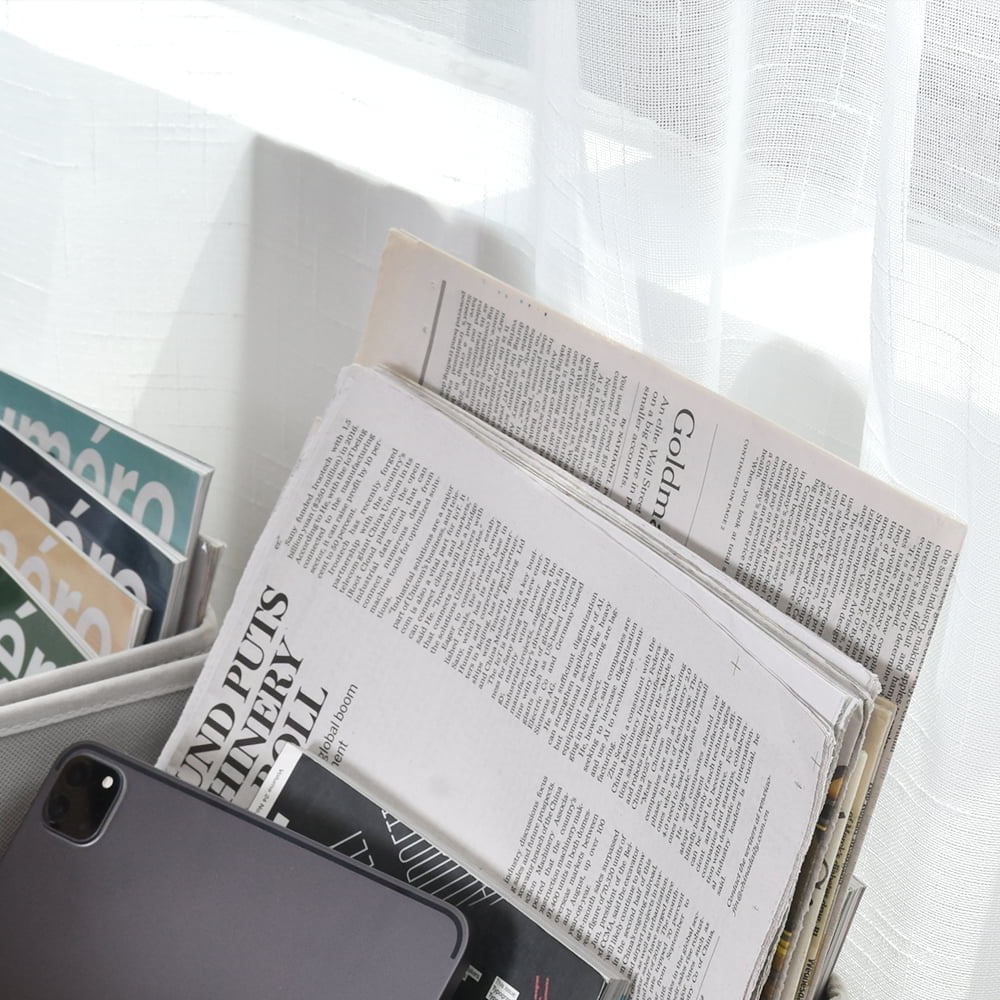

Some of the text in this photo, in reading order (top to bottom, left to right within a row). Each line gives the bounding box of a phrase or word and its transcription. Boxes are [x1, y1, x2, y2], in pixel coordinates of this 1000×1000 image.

[620, 385, 649, 487] smaller accounts.
[629, 390, 658, 493] on a big future in
[634, 395, 669, 515] An elite Wall Street
[732, 438, 749, 488] CONTINUED
[721, 502, 732, 524] PAGE
[728, 488, 735, 502] ON
[882, 540, 934, 683] investor's ability to determine
[891, 536, 925, 627] ecutive is overpaid.
[895, 544, 941, 673] comparisons difficult and
[904, 548, 952, 672] the same industry, making
[222, 583, 290, 704] PUTS
[577, 616, 631, 757] He, however, said companies are
[583, 622, 637, 772] seeking to increase digitalization
[333, 683, 359, 722] boom
[590, 626, 643, 777] and use AI to revolutionize manu-
[596, 741, 616, 782] facturing.
